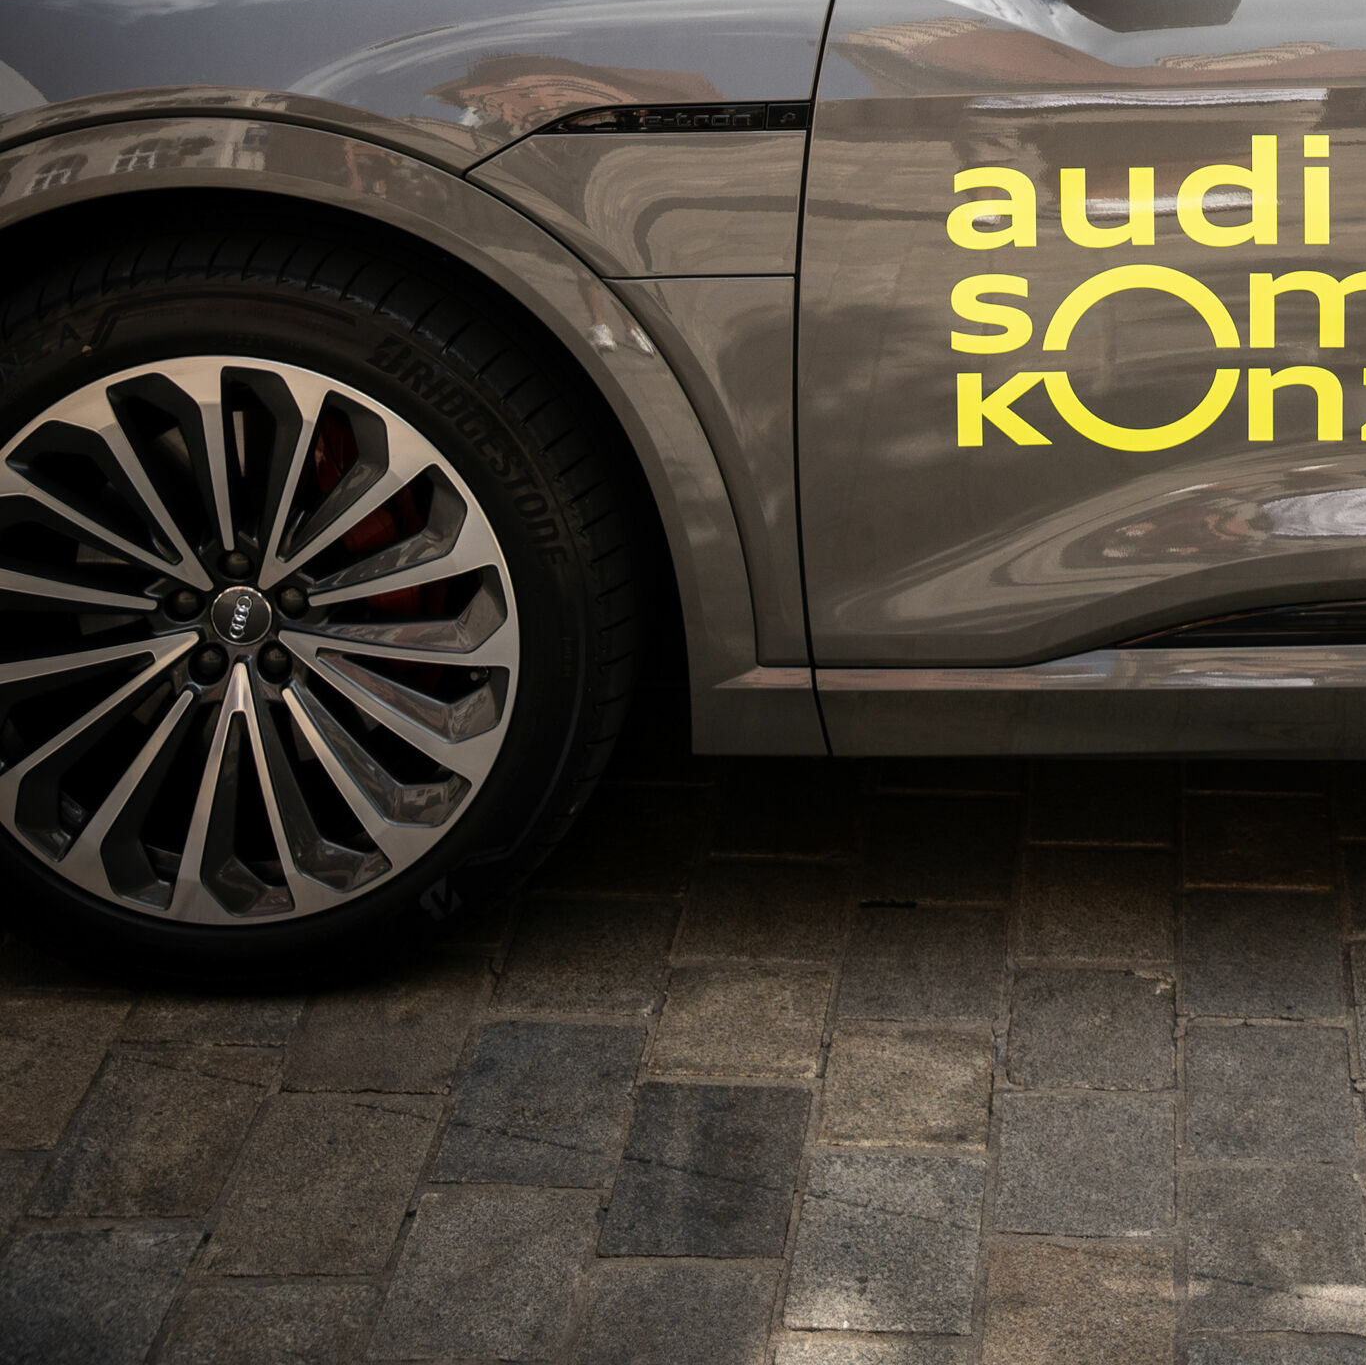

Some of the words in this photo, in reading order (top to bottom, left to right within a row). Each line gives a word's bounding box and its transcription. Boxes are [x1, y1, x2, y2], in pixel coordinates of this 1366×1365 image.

[642, 111, 752, 127] e-tron
[946, 135, 1331, 250] audi
[366, 334, 570, 566] BRIDGESTONE
